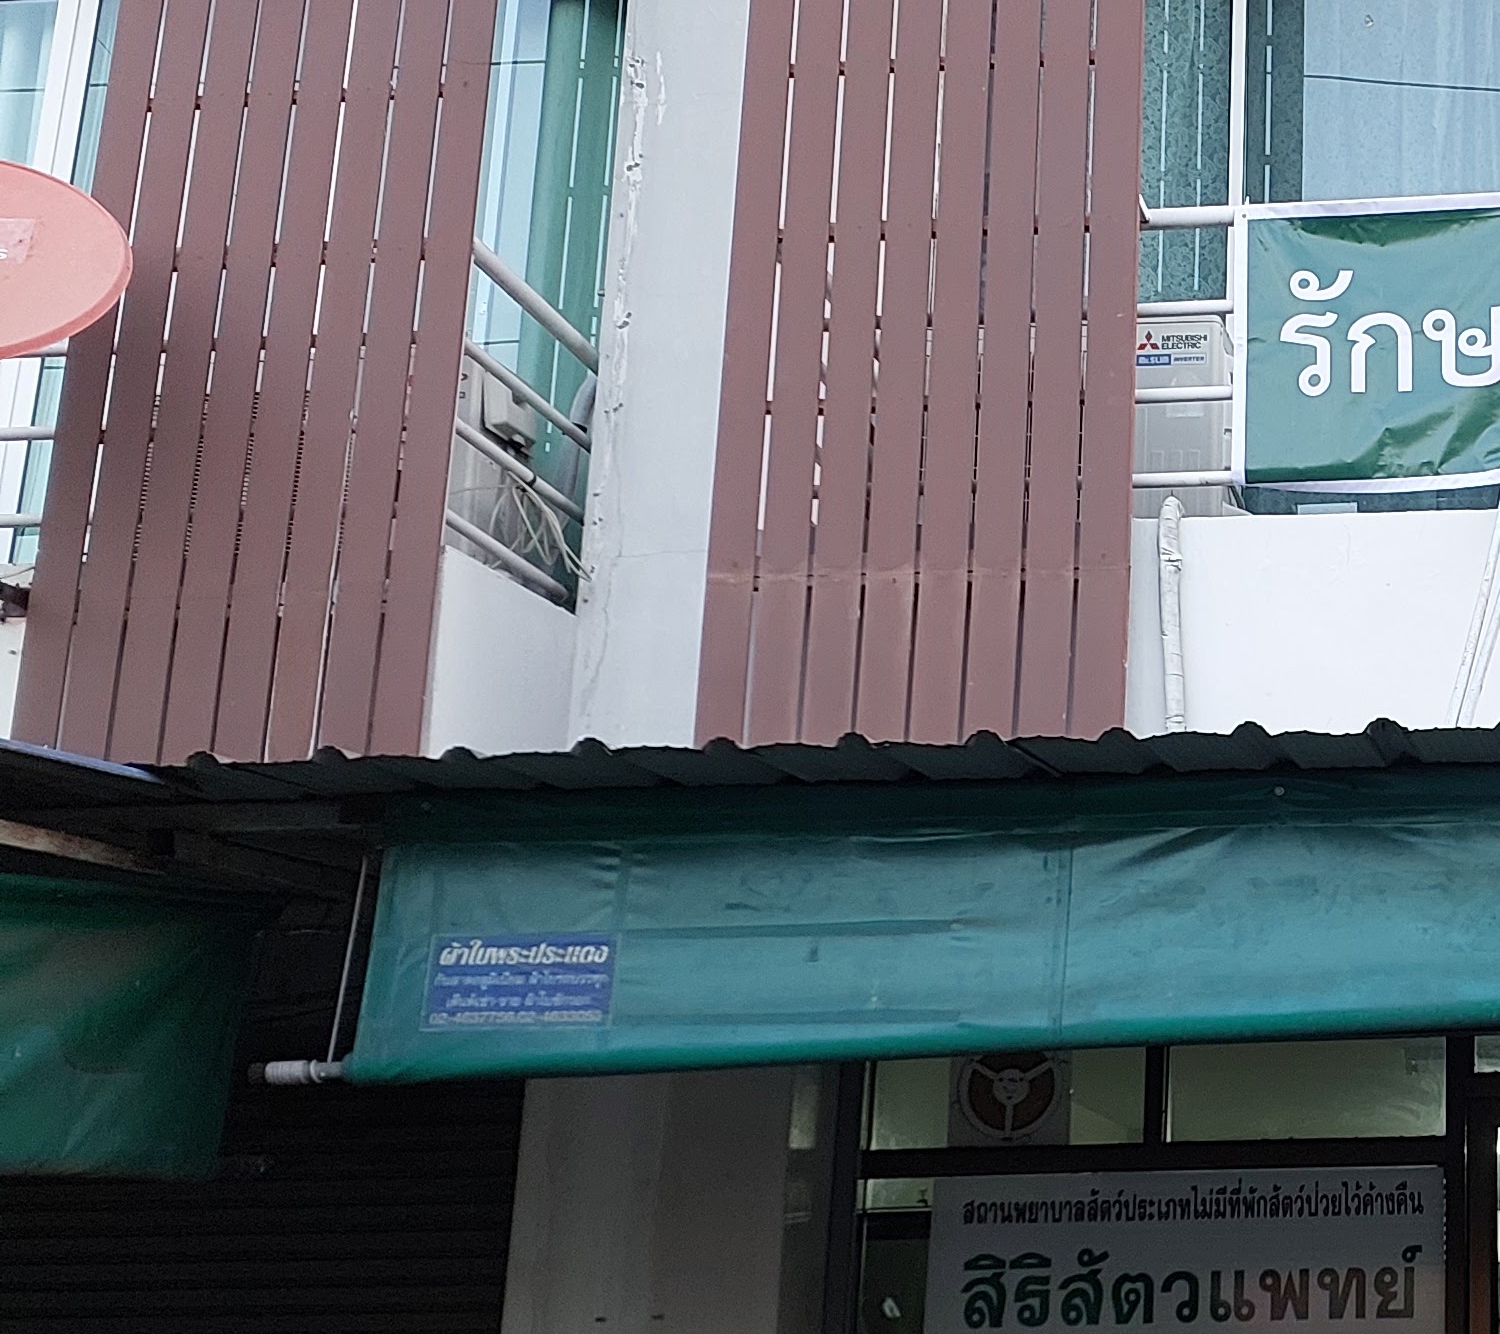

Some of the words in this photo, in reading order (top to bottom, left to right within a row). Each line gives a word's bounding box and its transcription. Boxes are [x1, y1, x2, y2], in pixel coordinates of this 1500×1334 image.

[1161, 334, 1208, 343] MITSUBISHI
[1161, 341, 1202, 350] ELECTRIC
[439, 939, 609, 966] ผ้าใบพระประแดง
[961, 1244, 1423, 1329] สิริสัตวแพทย์
